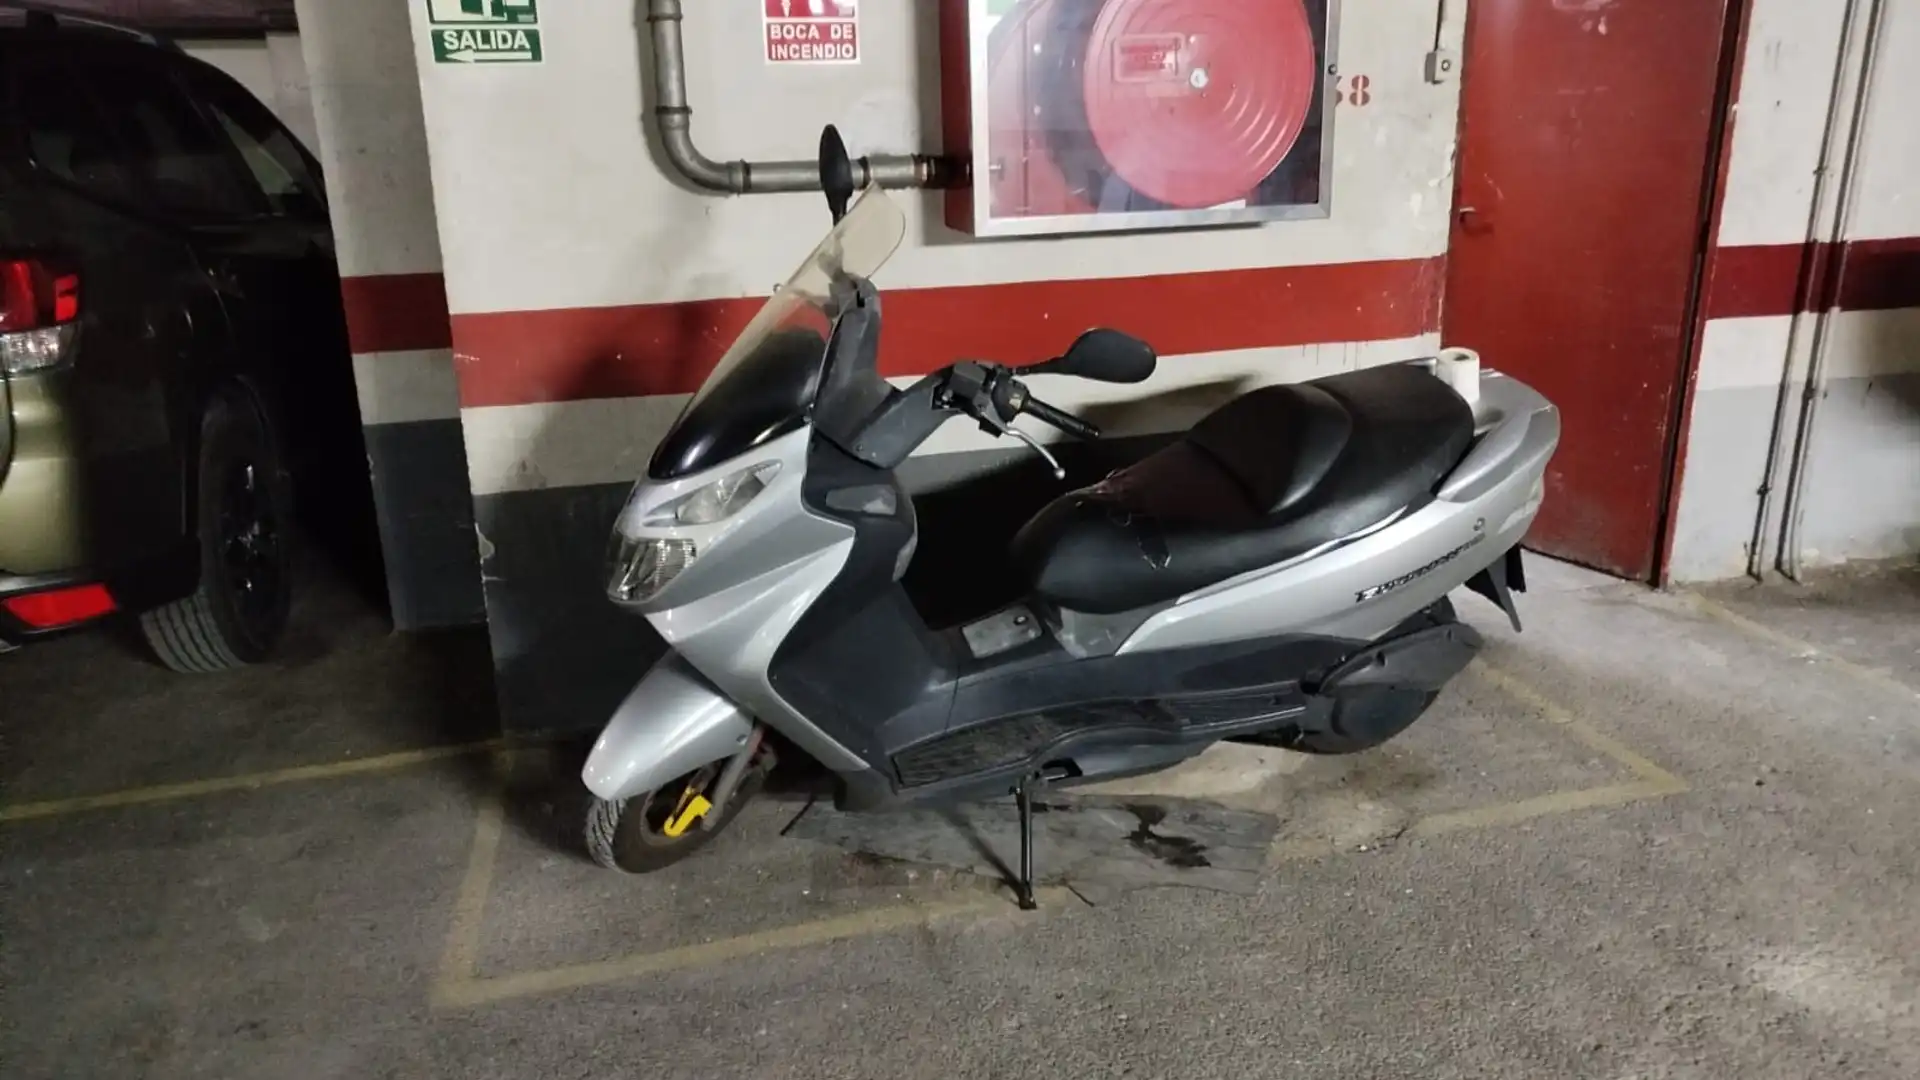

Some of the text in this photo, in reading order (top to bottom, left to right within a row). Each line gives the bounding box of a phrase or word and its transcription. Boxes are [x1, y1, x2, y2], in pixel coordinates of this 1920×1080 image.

[443, 30, 531, 50] SALIDA
[770, 23, 853, 40] BOCA DE
[771, 43, 854, 60] INCENDIO
